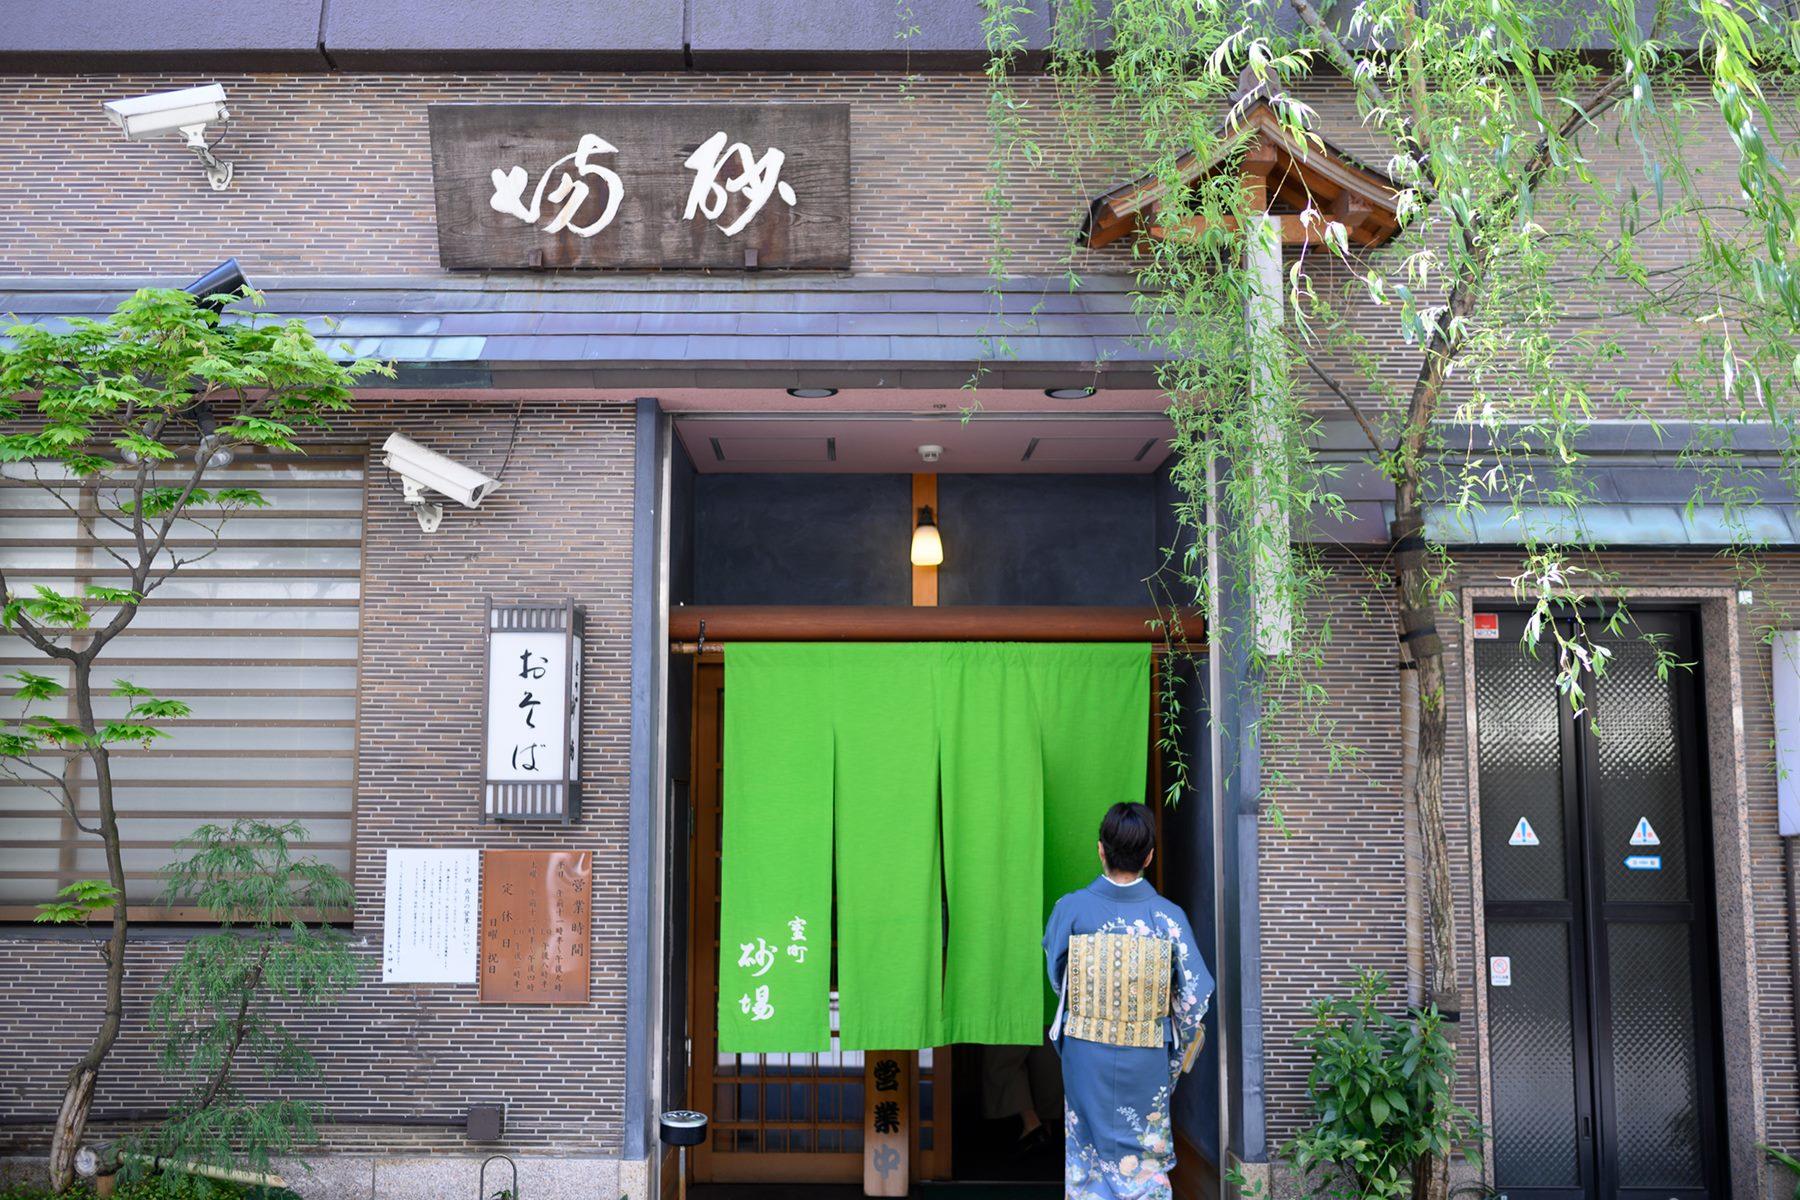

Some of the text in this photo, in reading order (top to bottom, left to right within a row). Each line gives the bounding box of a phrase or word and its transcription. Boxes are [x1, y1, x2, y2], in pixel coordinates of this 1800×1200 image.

[511, 648, 549, 772] おそば
[487, 918, 500, 974] 日曜 祝日
[501, 882, 514, 949] 定休日
[571, 878, 586, 957] 営業時間
[787, 915, 808, 964] 室町
[737, 937, 778, 1021] 砂場
[872, 1059, 901, 1181] 営業中
